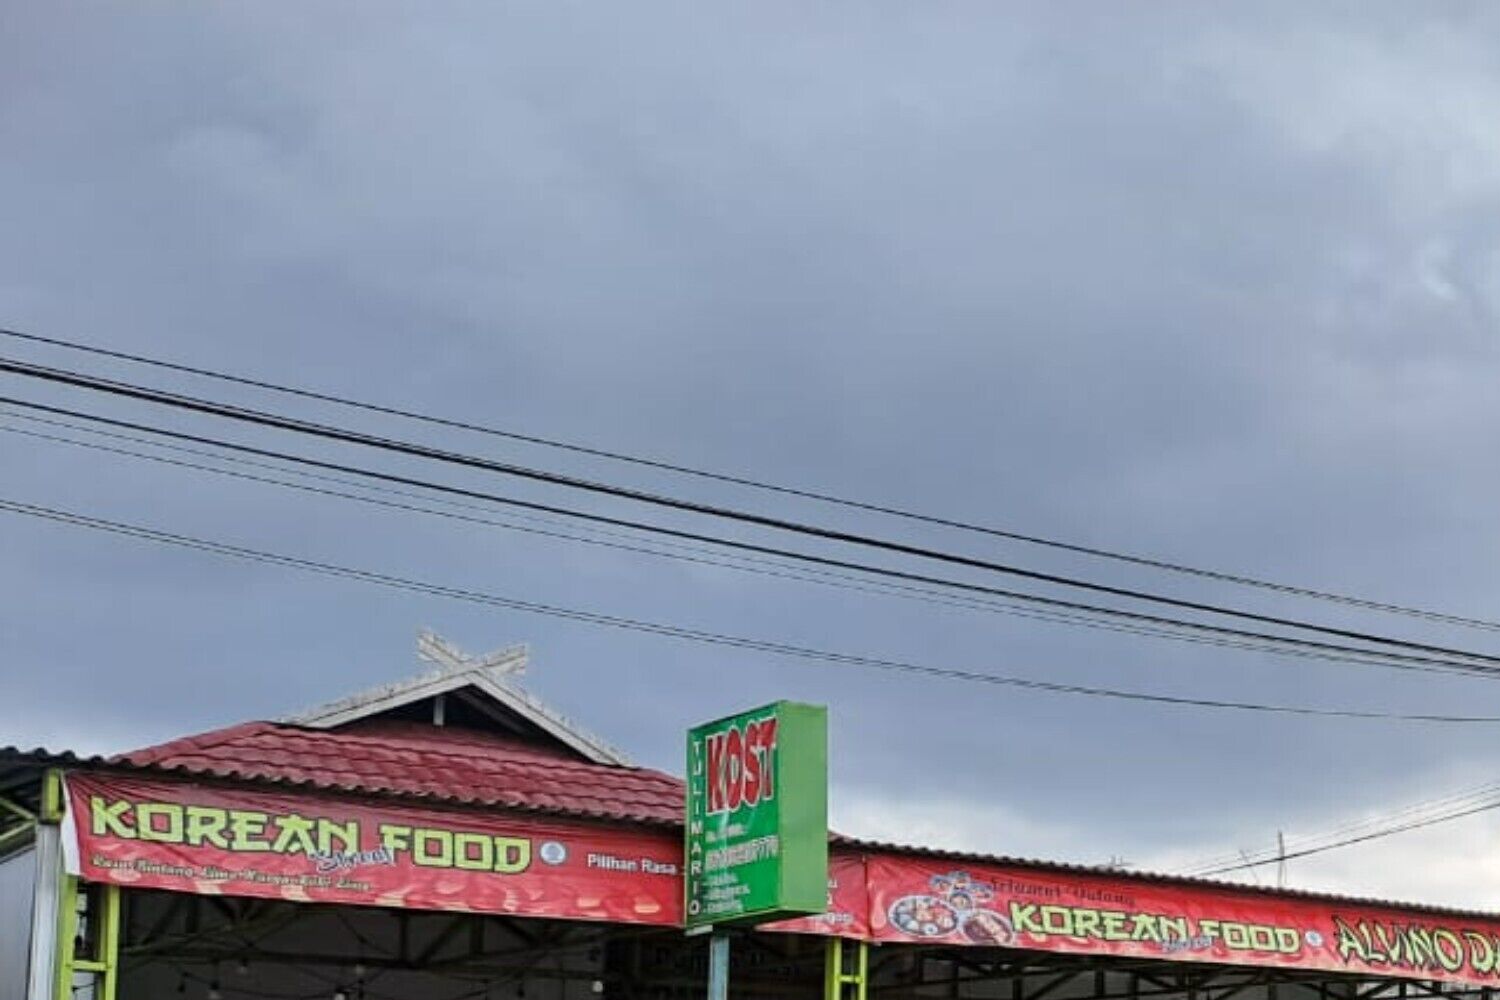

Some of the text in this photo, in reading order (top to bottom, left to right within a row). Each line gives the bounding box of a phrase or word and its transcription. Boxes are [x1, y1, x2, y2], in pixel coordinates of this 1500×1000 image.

[706, 716, 777, 813] KOST
[90, 795, 530, 874] KOREAN FOOD
[588, 854, 676, 874] Pilihan Rasa
[1010, 901, 1300, 952] KOREAN FOOD
[1332, 915, 1463, 973] ALVINO
